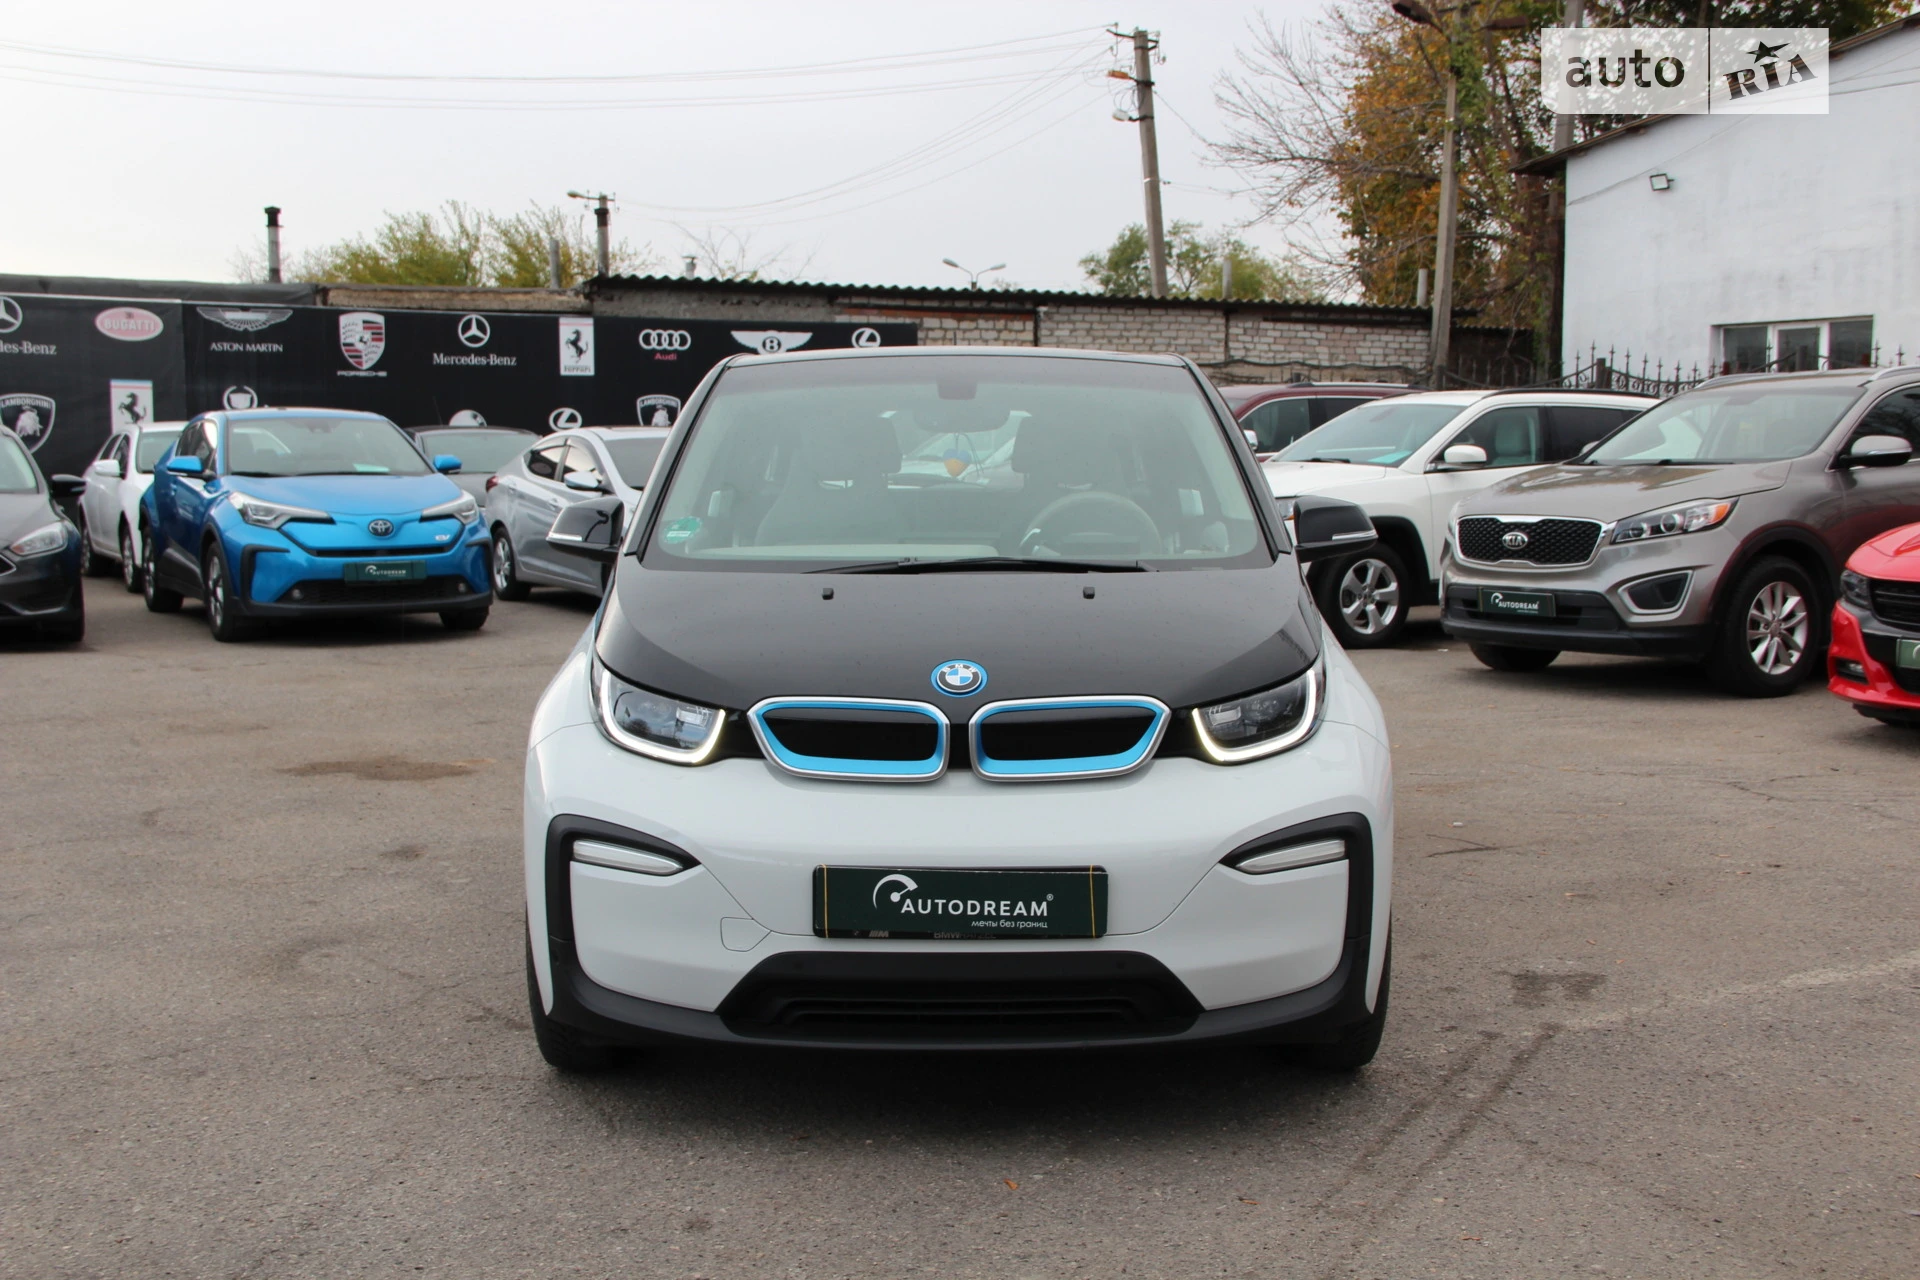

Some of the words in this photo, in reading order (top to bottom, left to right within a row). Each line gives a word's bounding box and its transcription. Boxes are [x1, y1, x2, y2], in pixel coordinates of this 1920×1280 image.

[103, 318, 155, 332] BUGATTI
[0, 340, 57, 355] es-Benz
[210, 342, 244, 352] ASTON
[245, 343, 283, 352] MARTIN
[432, 352, 517, 366] Mercedes-Benz
[654, 352, 677, 361] Audi
[1505, 535, 1523, 546] KIA
[1498, 601, 1539, 610] AUTODREAM
[942, 663, 977, 673] BMW
[999, 919, 1015, 928] без
[1016, 921, 1048, 930] границ
